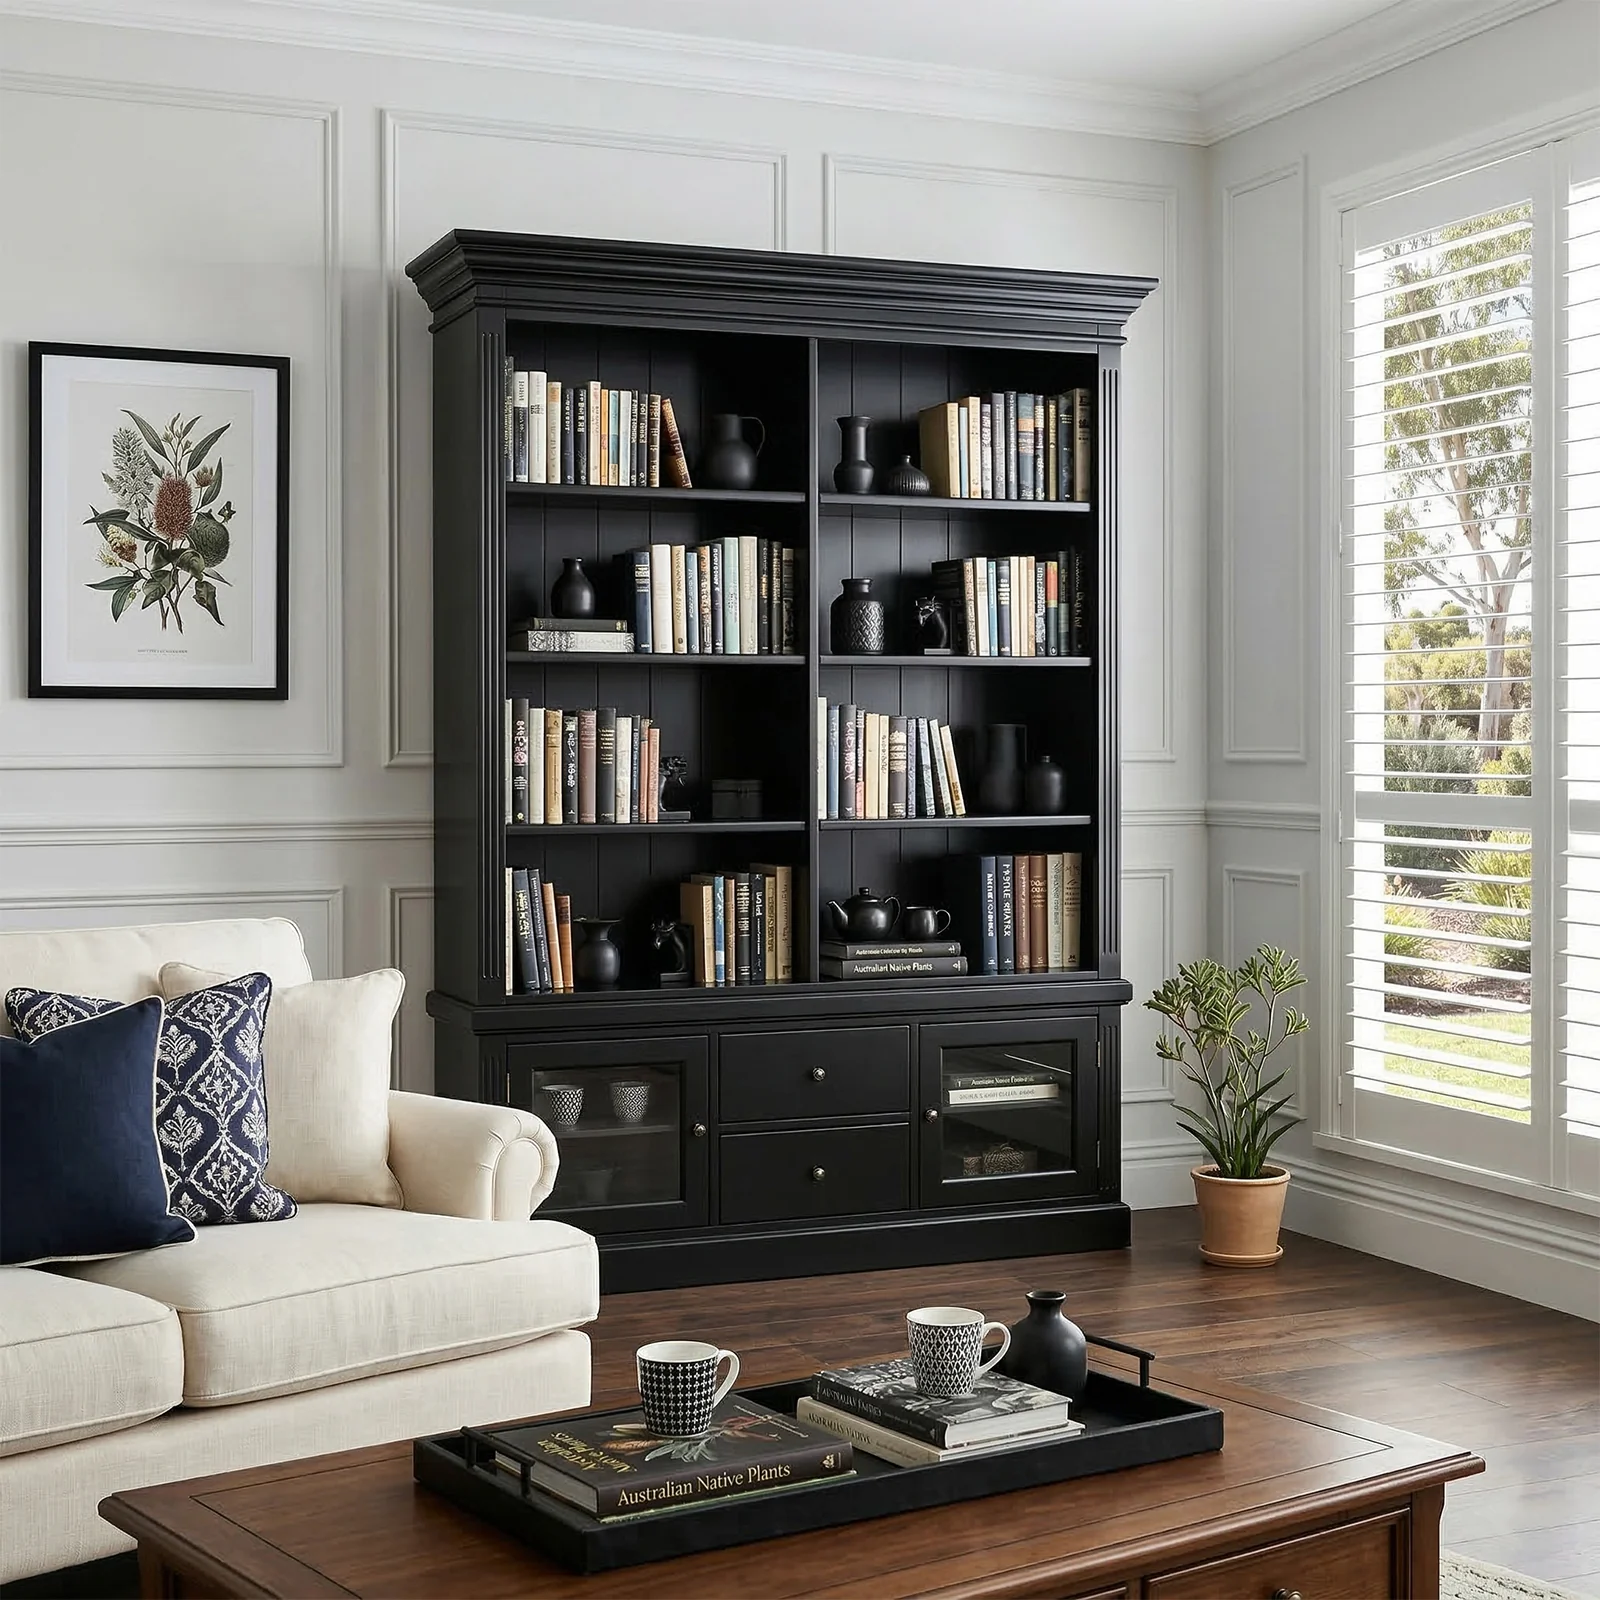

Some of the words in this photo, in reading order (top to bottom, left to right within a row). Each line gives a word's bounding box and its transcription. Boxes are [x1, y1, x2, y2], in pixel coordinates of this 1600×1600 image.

[889, 963, 912, 973] Native
[617, 1480, 693, 1507] Australian
[696, 1473, 744, 1493] Native
[747, 1461, 791, 1484] Plants
